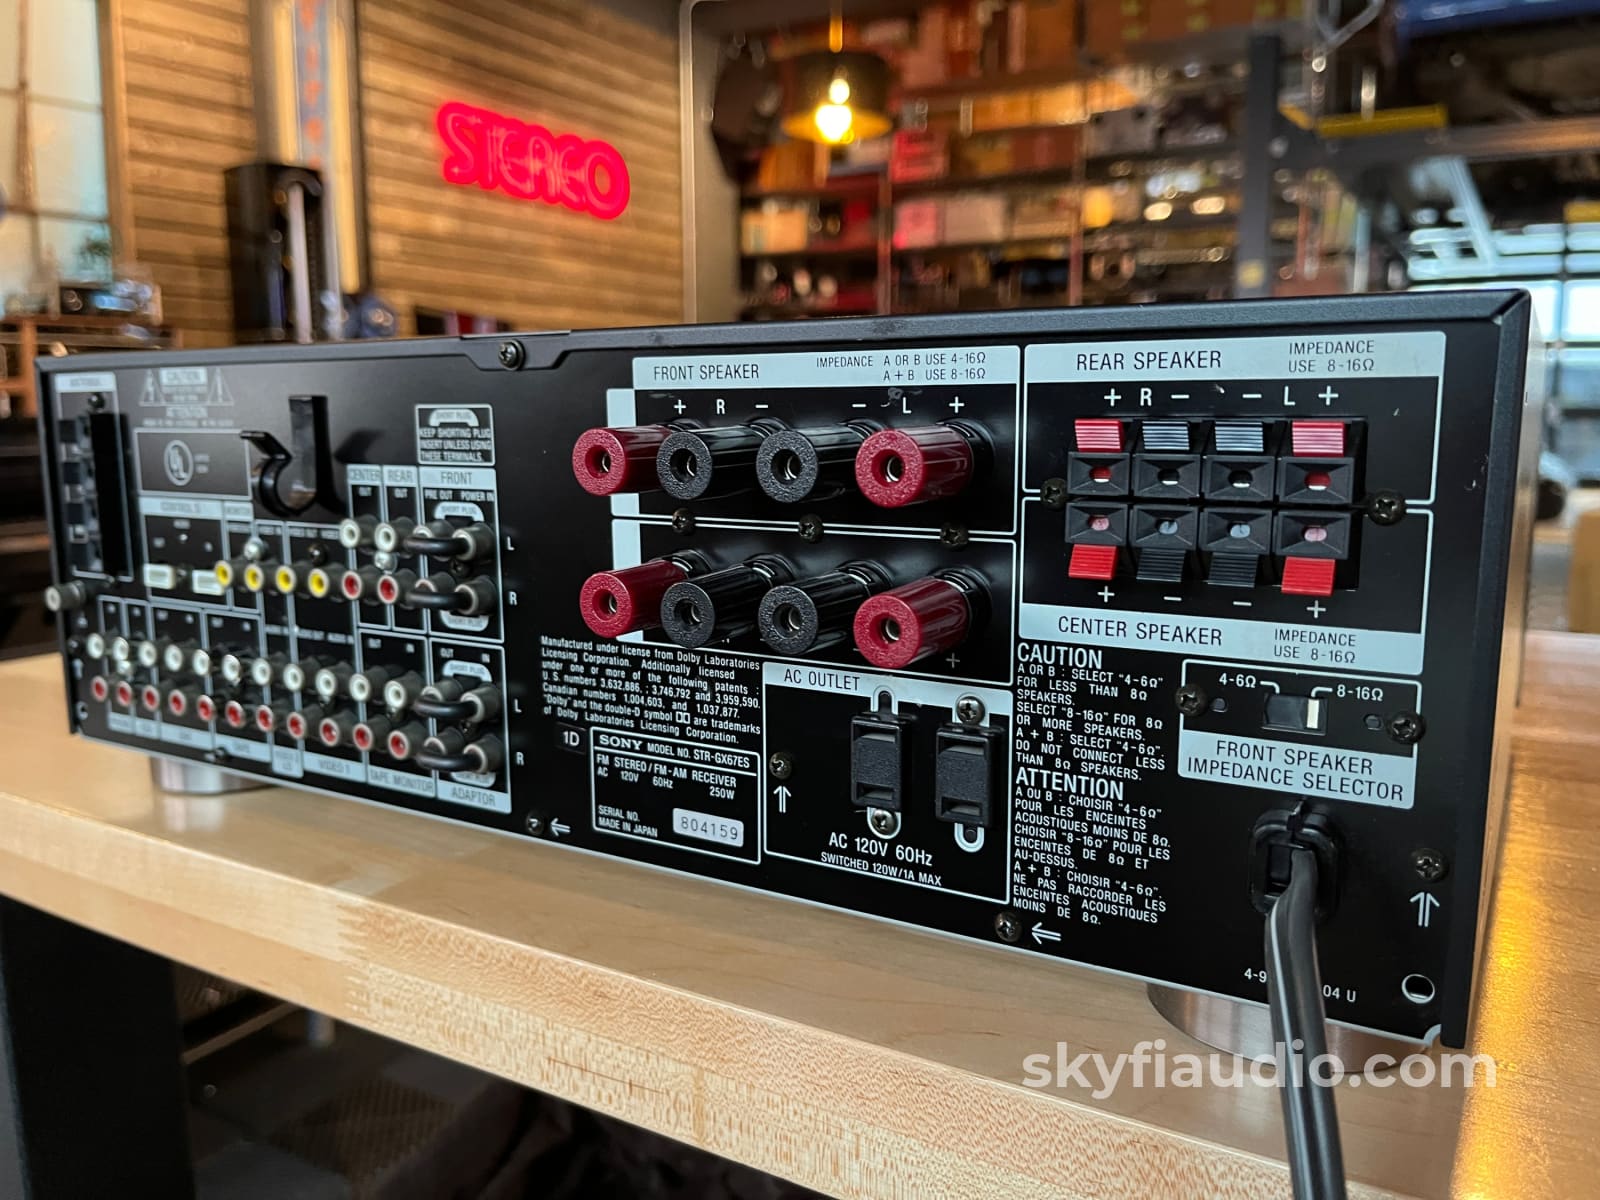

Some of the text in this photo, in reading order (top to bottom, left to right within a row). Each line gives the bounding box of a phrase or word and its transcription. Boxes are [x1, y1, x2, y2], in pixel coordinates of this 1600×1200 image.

[438, 103, 630, 219] STEREO
[1289, 340, 1374, 354] IMPEDANCE
[816, 354, 873, 368] IMPEDANCE
[884, 353, 891, 365] A
[895, 352, 909, 365] OR
[914, 353, 921, 365] B
[925, 352, 946, 366] USE
[1077, 350, 1222, 370] REAR SPEAKER
[1288, 360, 1316, 373] USE
[654, 364, 759, 381] FRONT SPEAKER
[883, 370, 890, 382] A
[908, 369, 915, 381] B
[925, 369, 946, 380] USE
[903, 398, 911, 414] L
[1140, 388, 1152, 405] R
[1284, 386, 1295, 405] L
[716, 400, 725, 415] R
[388, 470, 414, 482] REAR
[440, 472, 472, 484] FRONT
[507, 536, 515, 550] L
[509, 592, 517, 605] R
[1058, 615, 1223, 646] CENTER SPEAKER
[1274, 628, 1357, 647] IMPEDANCE
[541, 635, 760, 670] Manufactured under license from Dolby Laboratories
[542, 648, 735, 679] Licensing Additionally licensed
[1017, 642, 1102, 669] CAUTION
[1274, 645, 1300, 660] USE
[542, 660, 640, 680] under one or more of
[784, 668, 860, 691] AC OUTLET
[1018, 663, 1113, 683] A OR B SELECT
[1017, 676, 1037, 688] FOR
[1050, 679, 1077, 692] LESS
[1089, 684, 1118, 697] THAN
[1017, 689, 1075, 706] SPEAKERS.
[514, 700, 521, 712] L
[1017, 702, 1056, 716] SELECT
[1114, 713, 1136, 726] FOR
[544, 705, 679, 736] of Dolby Laboratories Licensing
[1017, 715, 1146, 741] OR MORE SPEAKERS.
[562, 731, 580, 747] 1D
[1016, 727, 1112, 750] A B SELECT
[517, 752, 524, 765] R
[600, 735, 750, 768] SONY MODEL NO. STR-GX67ES
[1016, 740, 1165, 771] DO NOT CONNECT LESS
[1216, 740, 1373, 776] FRONT SPEAKER
[597, 754, 736, 788] FM RECEIVER
[1016, 752, 1043, 766] THAN
[1081, 762, 1142, 780] SPEAKERS.
[597, 766, 674, 789] AC 120V 60Hz
[1016, 766, 1124, 800] ATTENTION
[1188, 756, 1403, 802] IMPEDANCE SELECTOR
[452, 788, 496, 806] ADAPTOR
[709, 786, 735, 800] 250W
[1015, 786, 1113, 811] A OU B CHOISIR
[599, 805, 639, 822] SERIAL NO.
[1015, 799, 1147, 830] POUR LES ENCEINTES
[599, 817, 658, 838] MADE IN JAPAN
[681, 816, 738, 840] 804159
[1015, 812, 1147, 844] ACOUSTIQUES MOINS DE
[829, 832, 933, 867] AC 120V 60Hz
[1014, 836, 1071, 856] ENCEINTES
[1082, 848, 1096, 860] DE
[1135, 858, 1149, 869] ET
[1015, 823, 1170, 860] CHOISIR POUR LES
[821, 851, 941, 886] SWITCHED 120W/1A MAX
[1014, 848, 1078, 870] AU-DESSUS.
[1014, 861, 1110, 888] A B CHOISIR
[1013, 873, 1166, 912] NE PAS RACCORDER LES
[1013, 885, 1158, 924] ENCEINTES ACOUSTIQUES
[1013, 897, 1071, 919] MOINS DE
